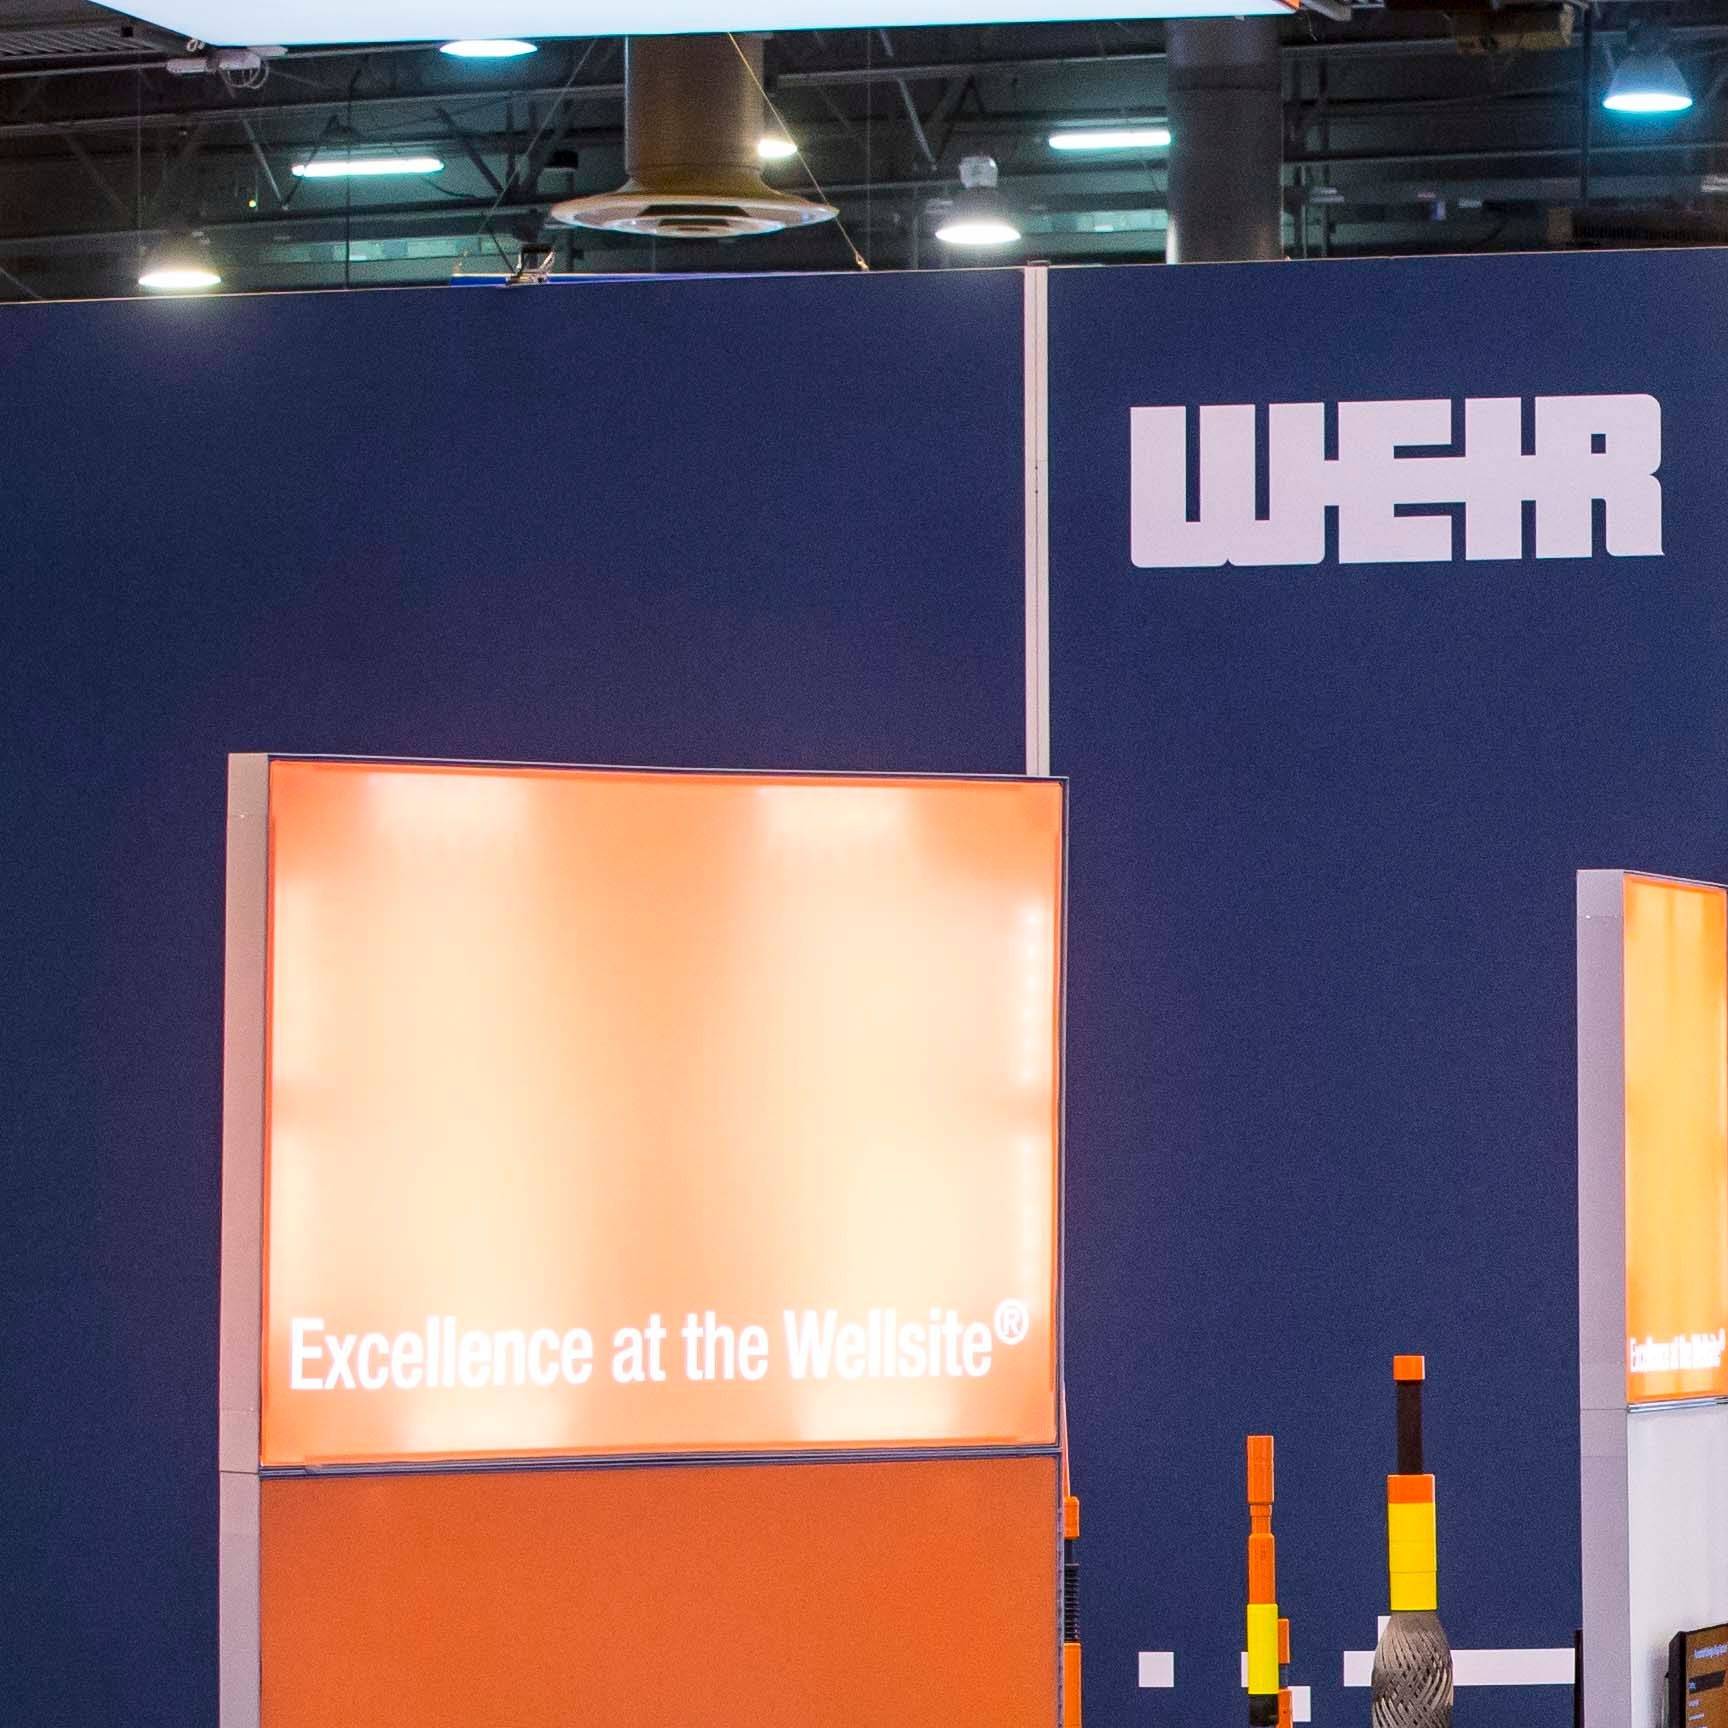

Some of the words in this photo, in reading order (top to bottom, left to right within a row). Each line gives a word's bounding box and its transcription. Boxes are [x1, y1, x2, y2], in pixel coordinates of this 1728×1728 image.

[1130, 393, 1664, 568] WEIR
[290, 1316, 593, 1391] Excellence
[611, 1313, 668, 1384] at
[681, 1310, 769, 1381] the
